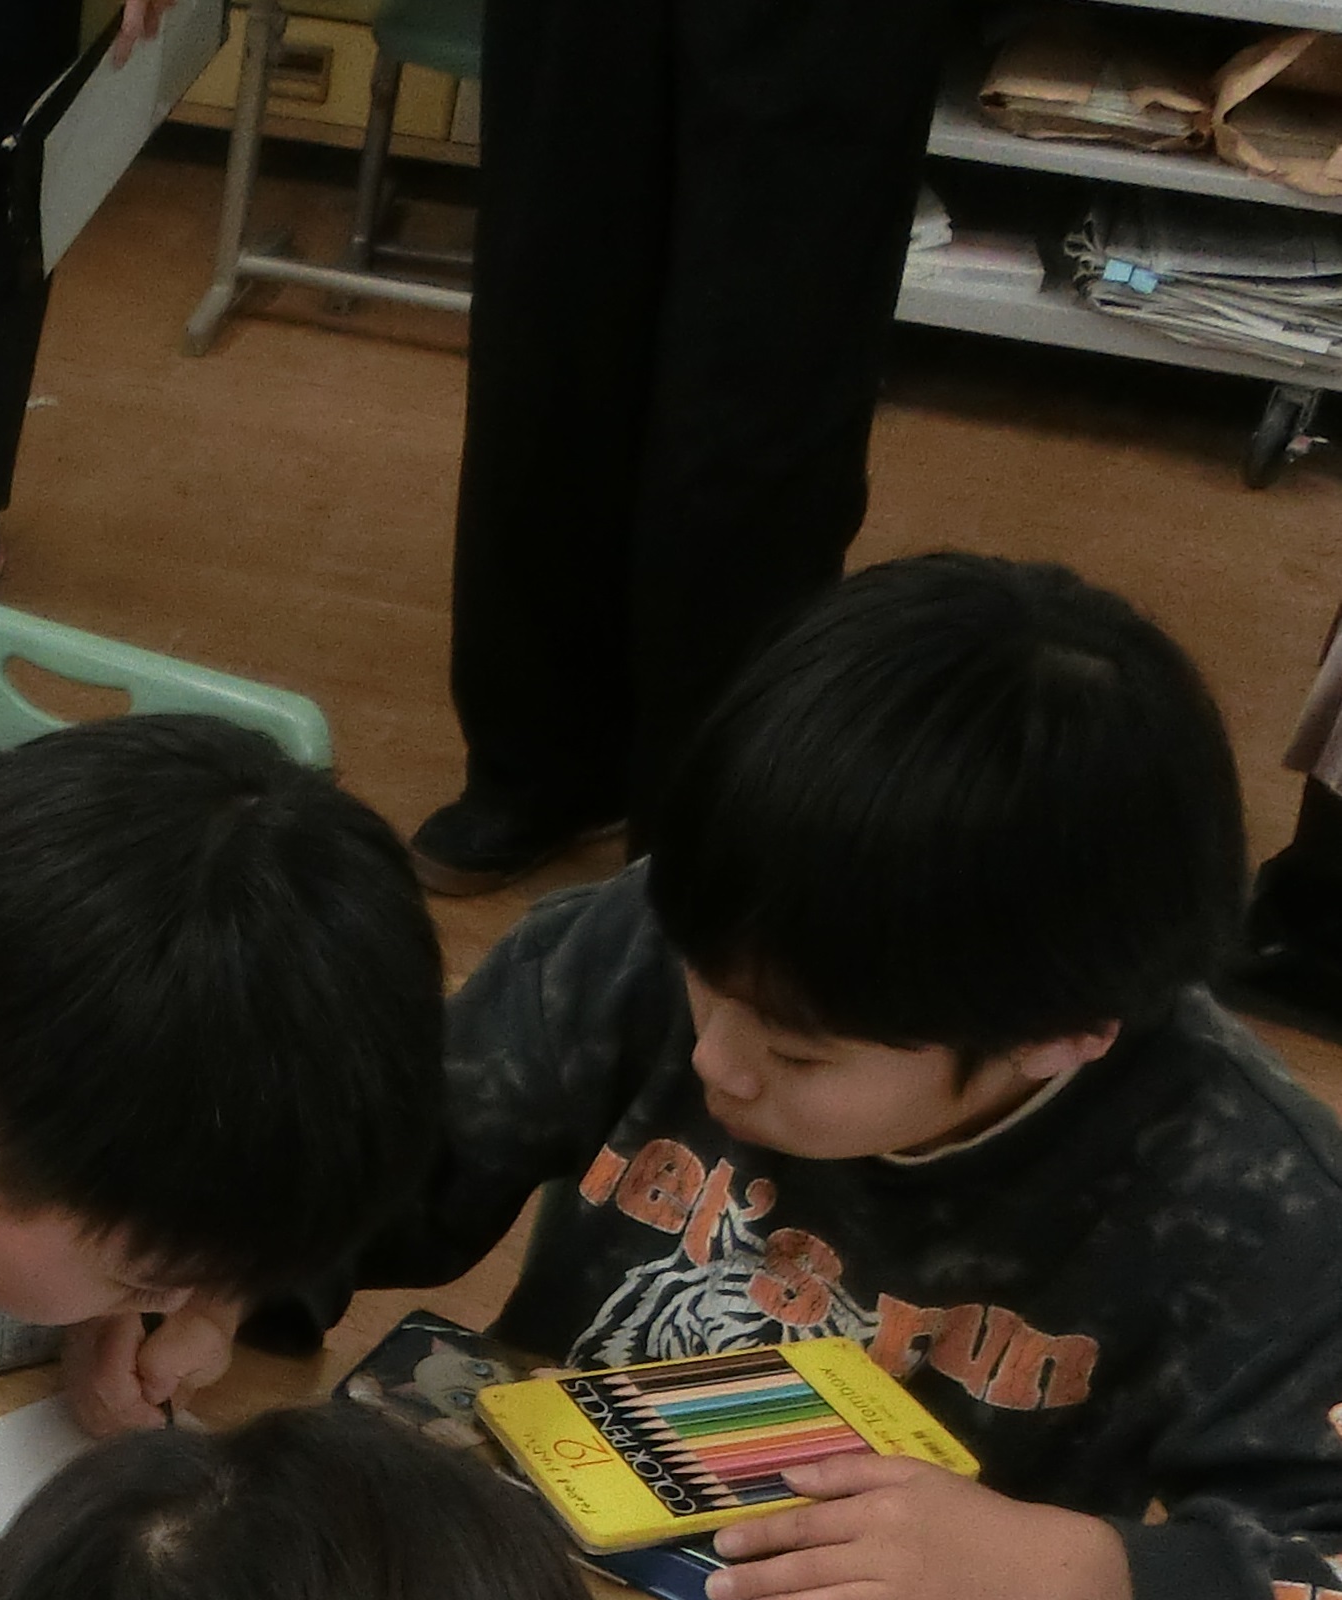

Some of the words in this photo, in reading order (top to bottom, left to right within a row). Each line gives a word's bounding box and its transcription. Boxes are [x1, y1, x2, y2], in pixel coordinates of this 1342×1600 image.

[564, 1379, 640, 1448] PENCILS
[820, 1366, 883, 1428] Tombow
[554, 1436, 613, 1469] 12
[624, 1448, 696, 1514] COLOR
